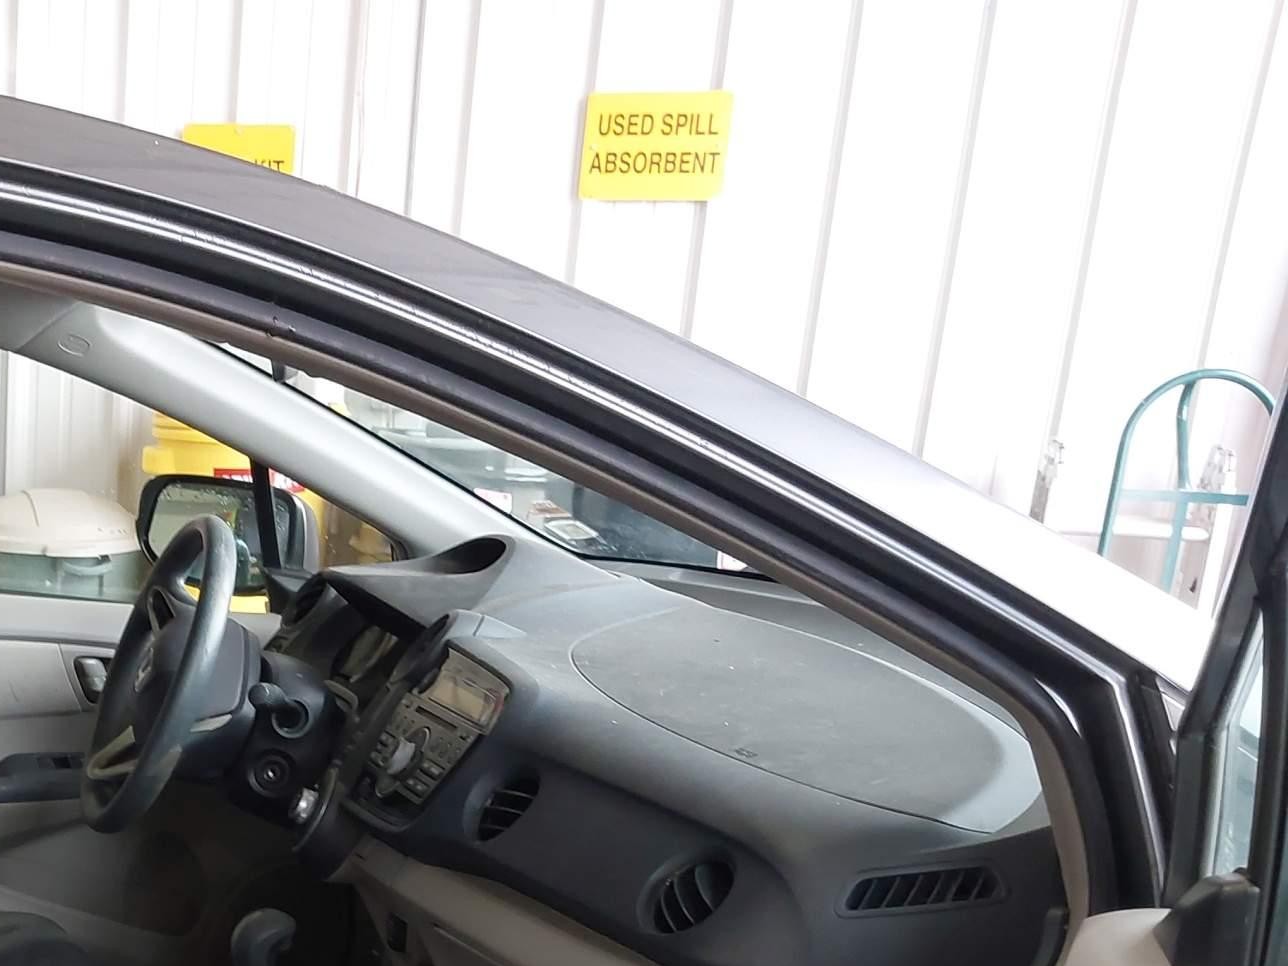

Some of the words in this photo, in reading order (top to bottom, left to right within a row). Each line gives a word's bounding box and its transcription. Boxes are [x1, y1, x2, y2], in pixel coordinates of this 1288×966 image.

[599, 113, 654, 135] USED
[660, 113, 719, 135] SPILL
[589, 152, 720, 174] ABSORBENT
